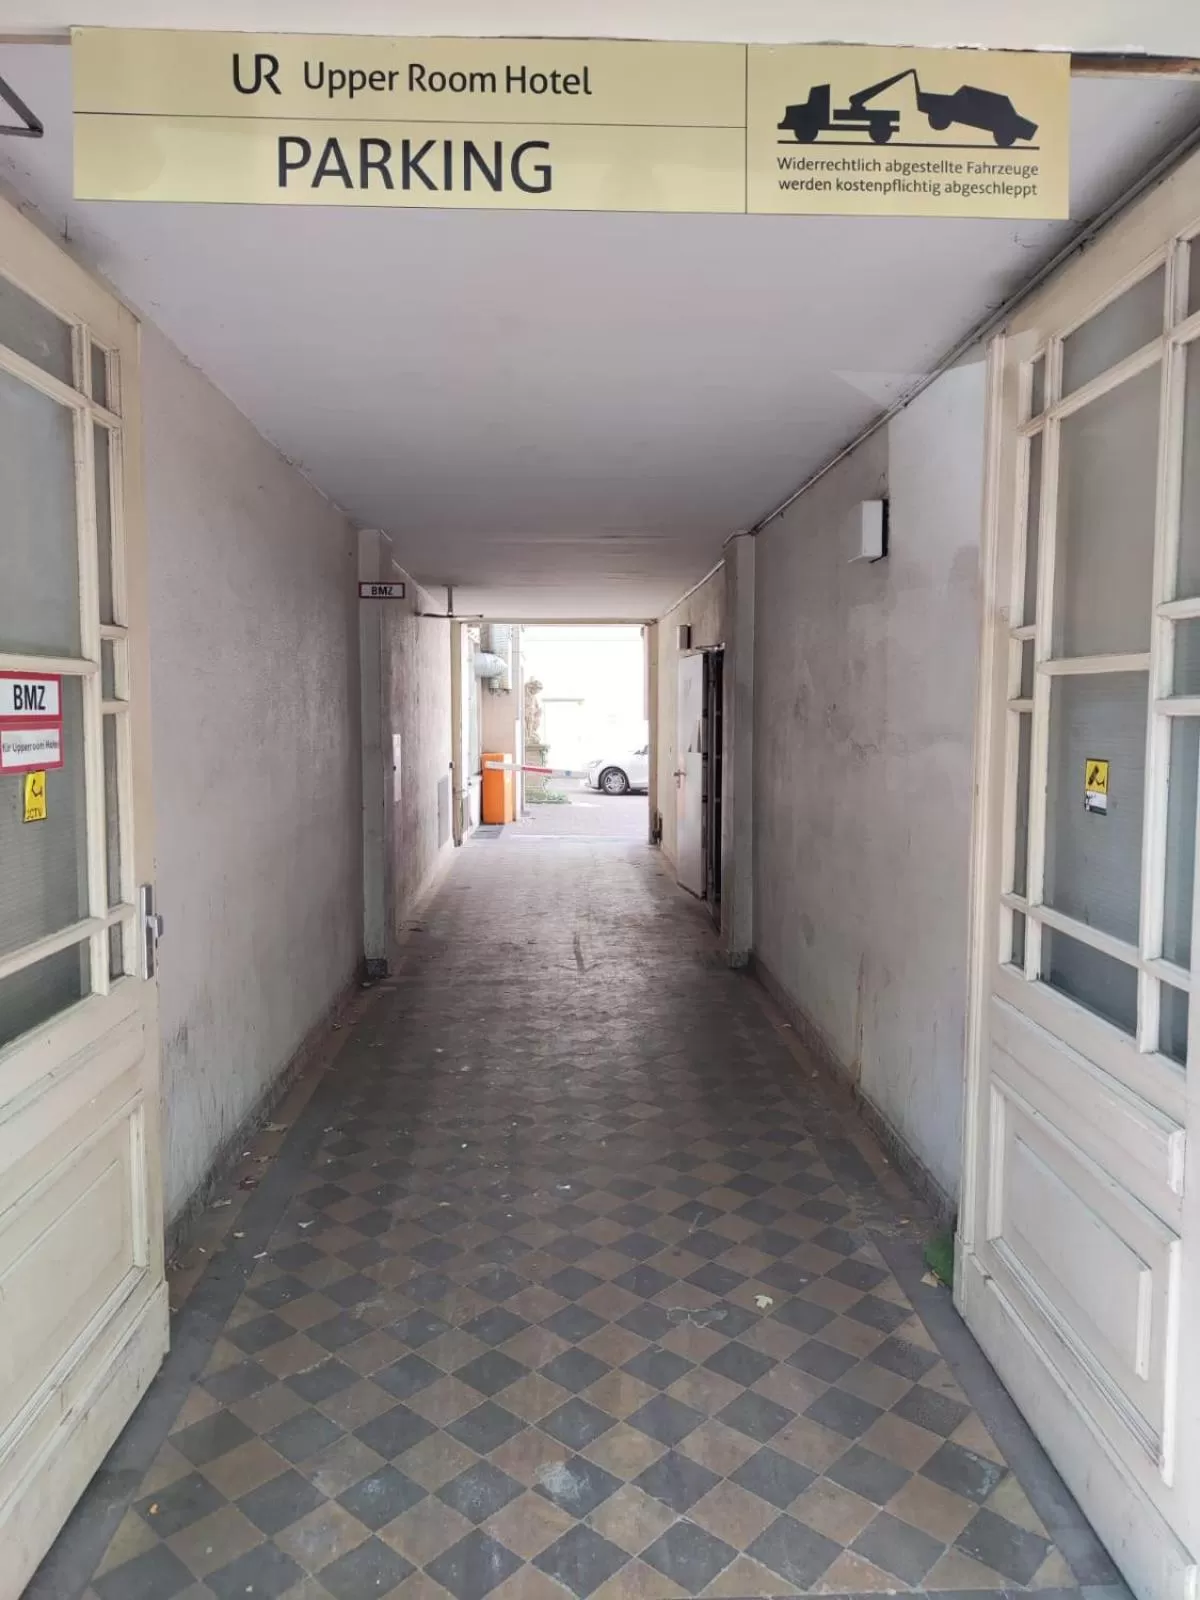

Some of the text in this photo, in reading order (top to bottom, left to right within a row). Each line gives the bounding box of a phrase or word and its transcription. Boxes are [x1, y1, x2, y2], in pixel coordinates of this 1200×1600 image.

[233, 54, 593, 99] UR Upper Room Hotel
[279, 136, 553, 194] PARKING
[777, 156, 1039, 179] Widerrechtlich abgestellte Fahrzeuge
[778, 177, 1037, 198] werden kostenpflichtig abgeschleppt
[371, 586, 393, 595] BMZ
[13, 684, 46, 711] BMZ
